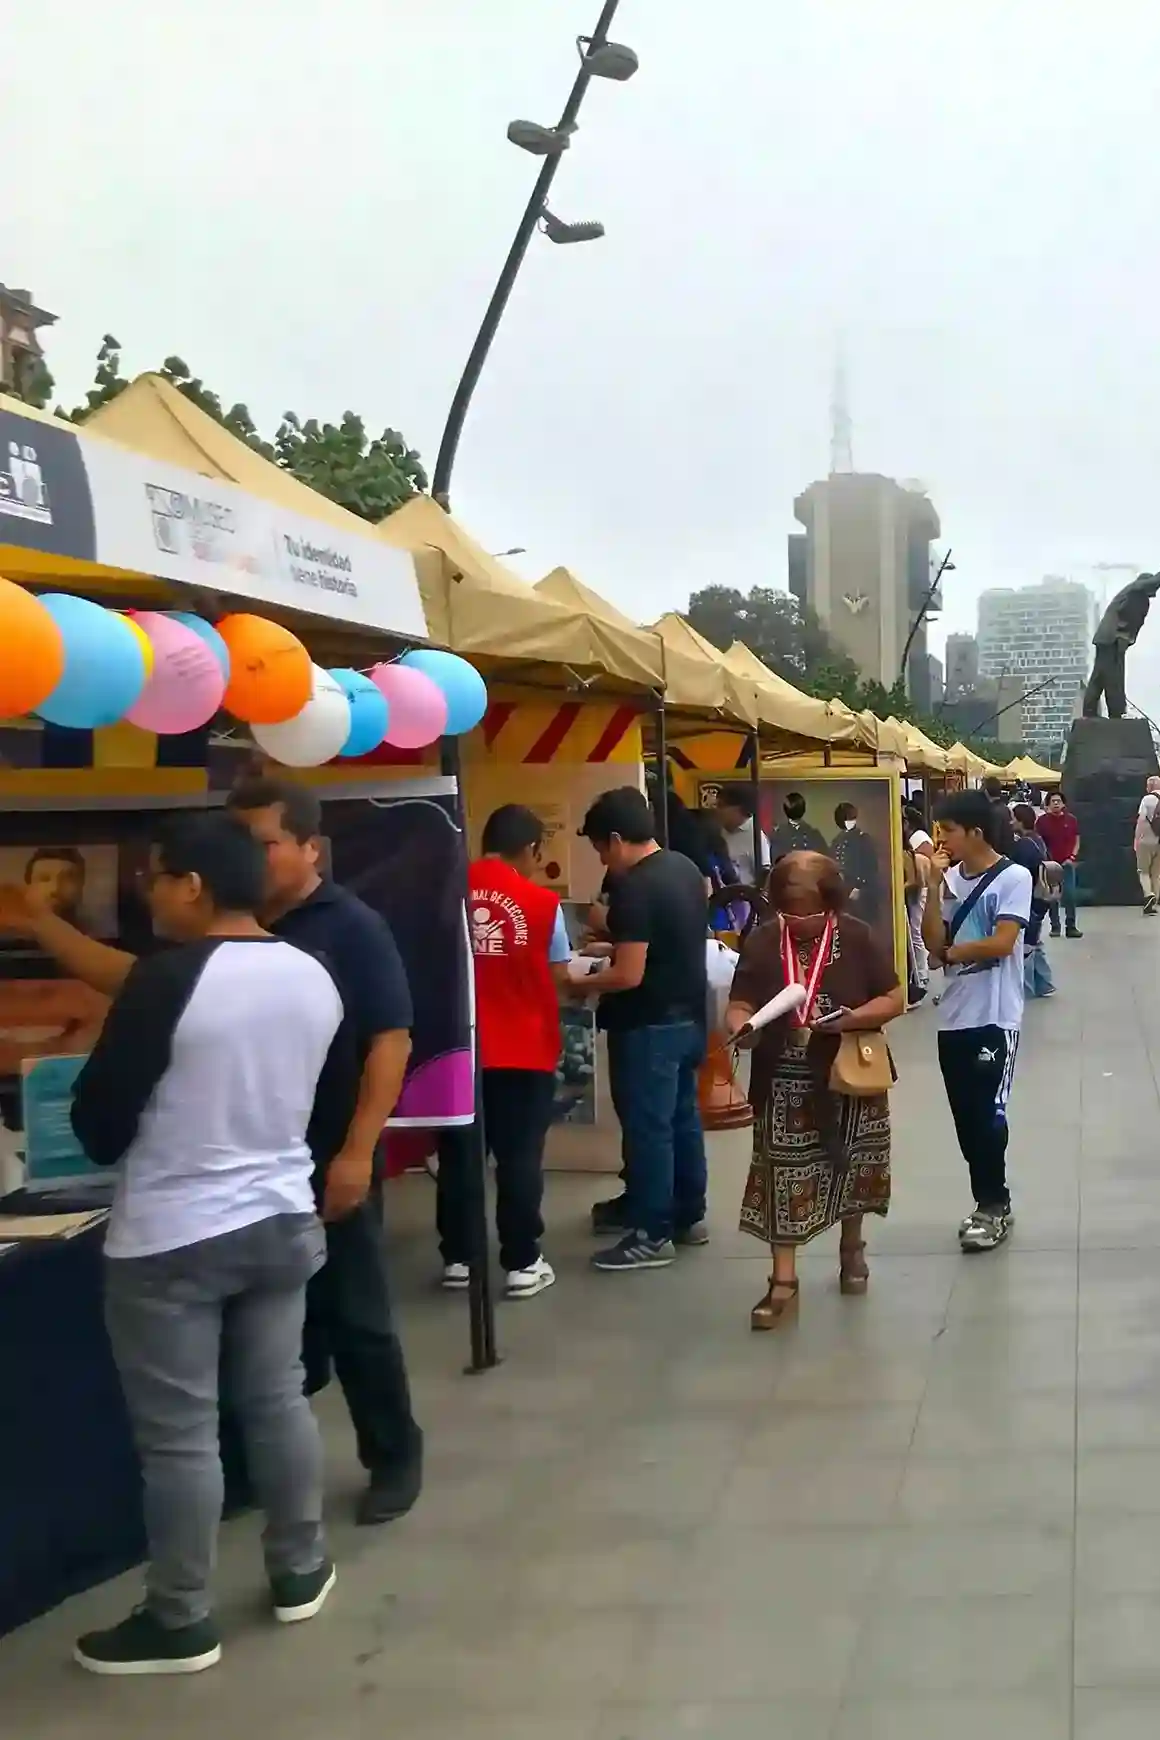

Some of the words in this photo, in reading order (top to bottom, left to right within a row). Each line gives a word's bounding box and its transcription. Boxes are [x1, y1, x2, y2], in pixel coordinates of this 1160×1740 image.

[490, 891, 504, 904] DE
[500, 896, 528, 946] ELECCIONES
[474, 939, 504, 953] NE
